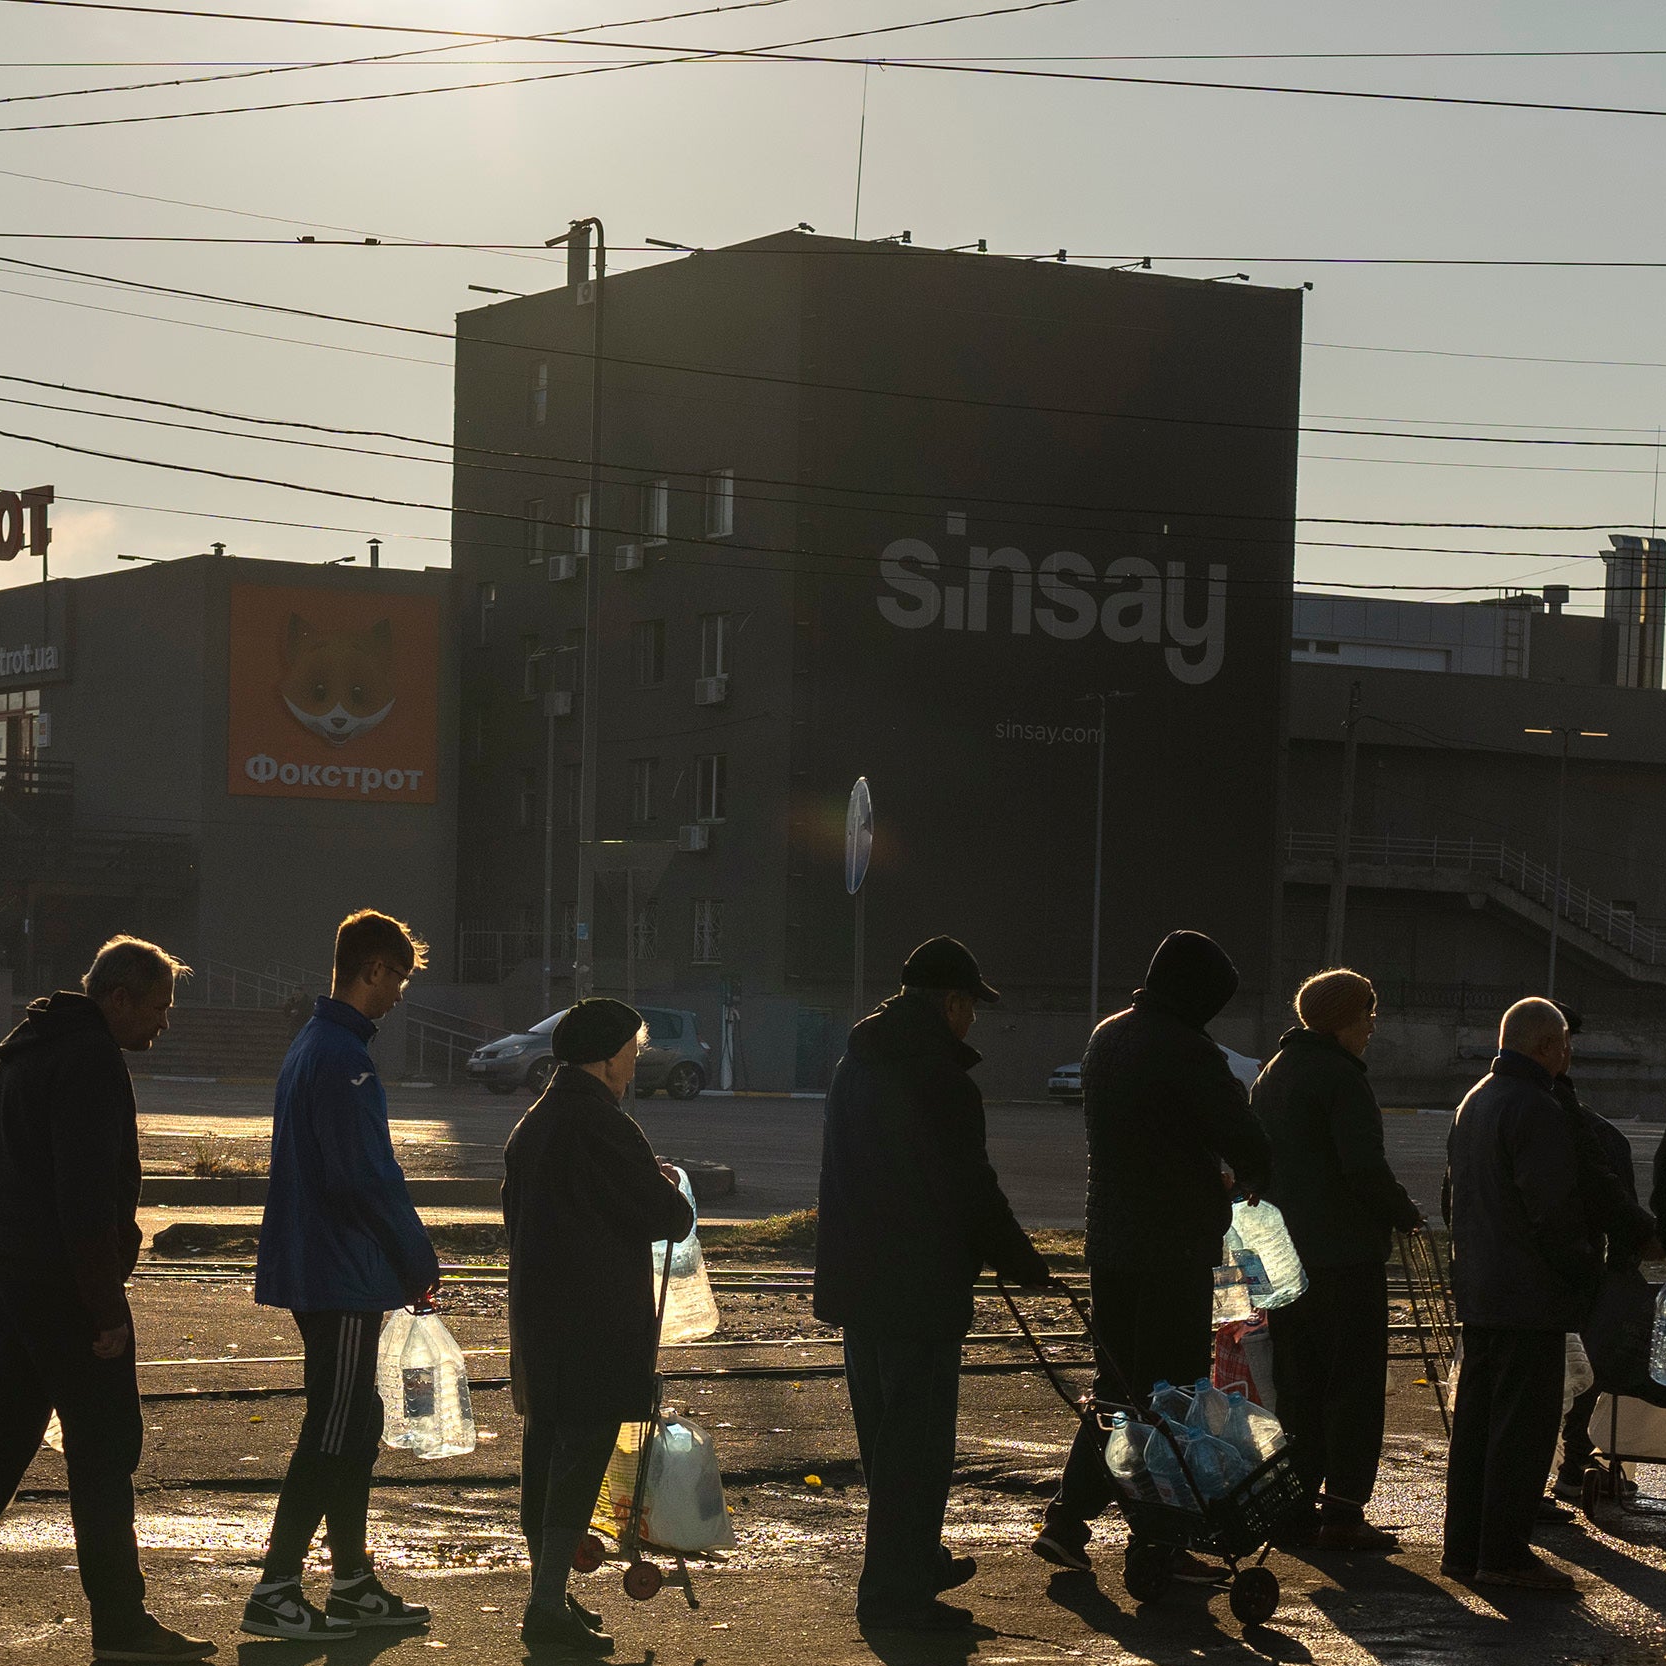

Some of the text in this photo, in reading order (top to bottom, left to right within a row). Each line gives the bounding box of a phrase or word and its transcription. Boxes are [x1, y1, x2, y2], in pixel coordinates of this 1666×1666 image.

[876, 511, 1227, 684] sinsay
[995, 719, 1105, 746] sinsay.com
[244, 753, 425, 794] Фокстрот
